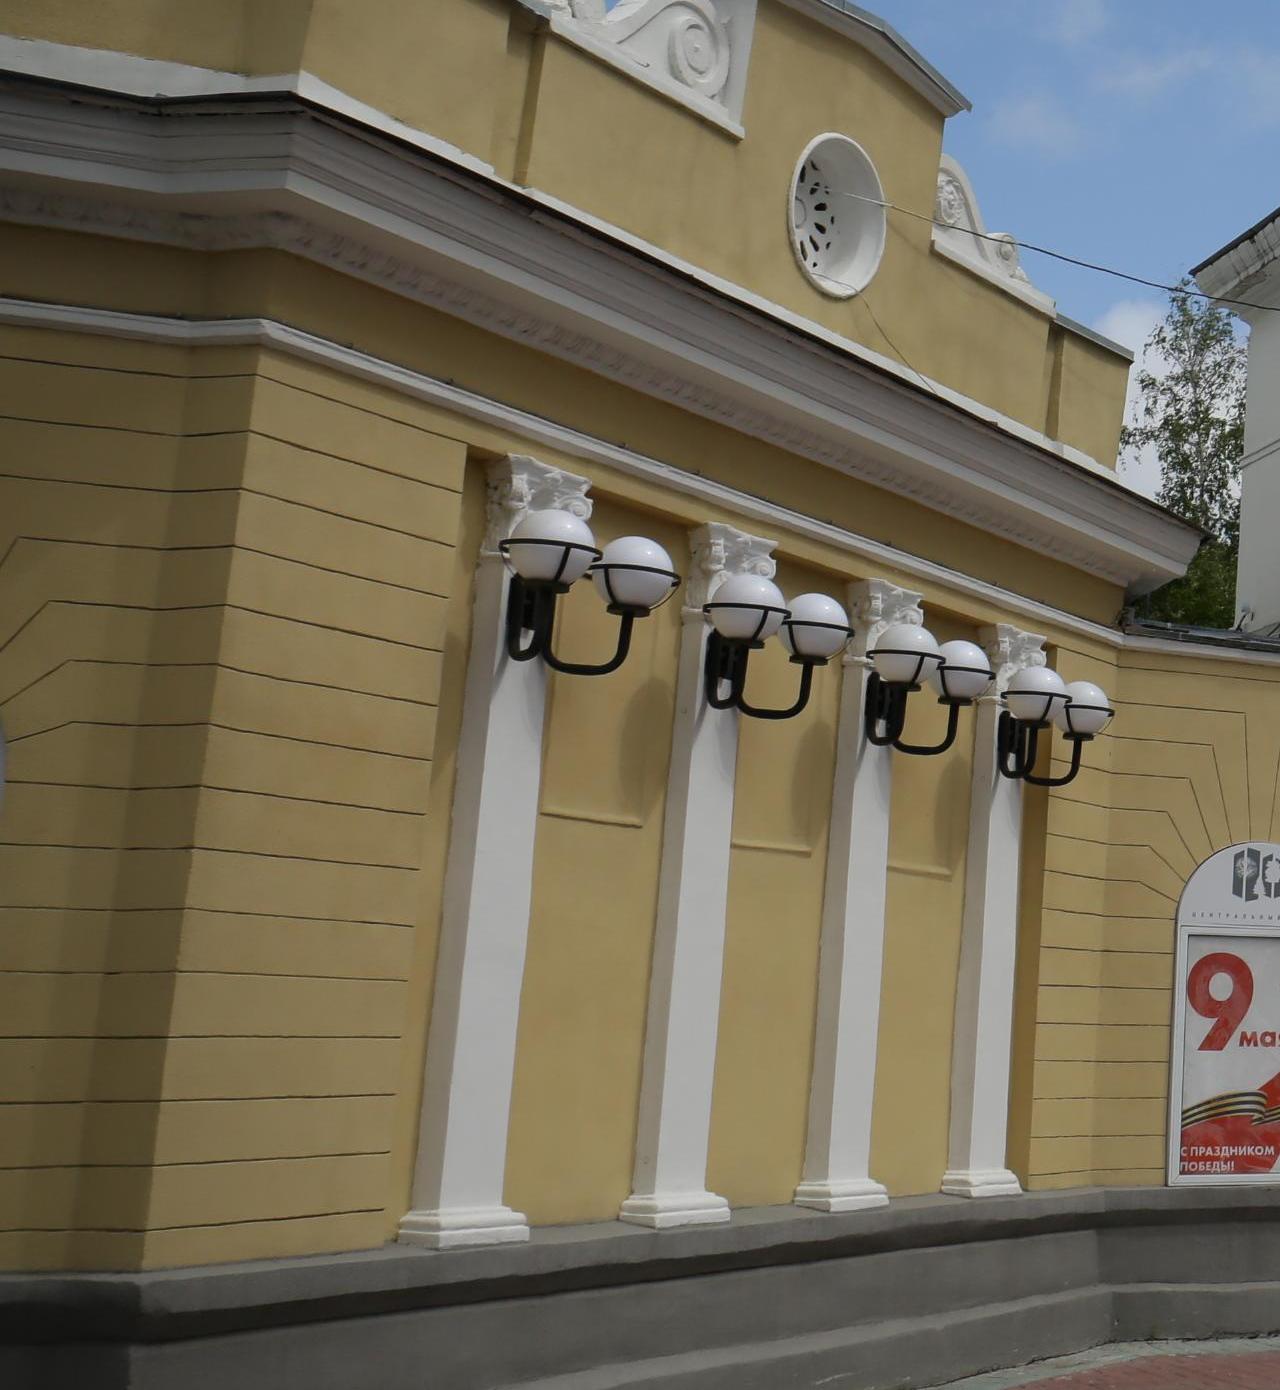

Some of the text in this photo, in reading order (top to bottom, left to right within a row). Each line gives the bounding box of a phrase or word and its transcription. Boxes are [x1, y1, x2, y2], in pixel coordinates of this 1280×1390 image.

[1187, 952, 1254, 1051] 9
[1180, 1145, 1275, 1158] С ПРАЗДНИКОМ
[1180, 1160, 1235, 1173] ПОБЕДЫ!
